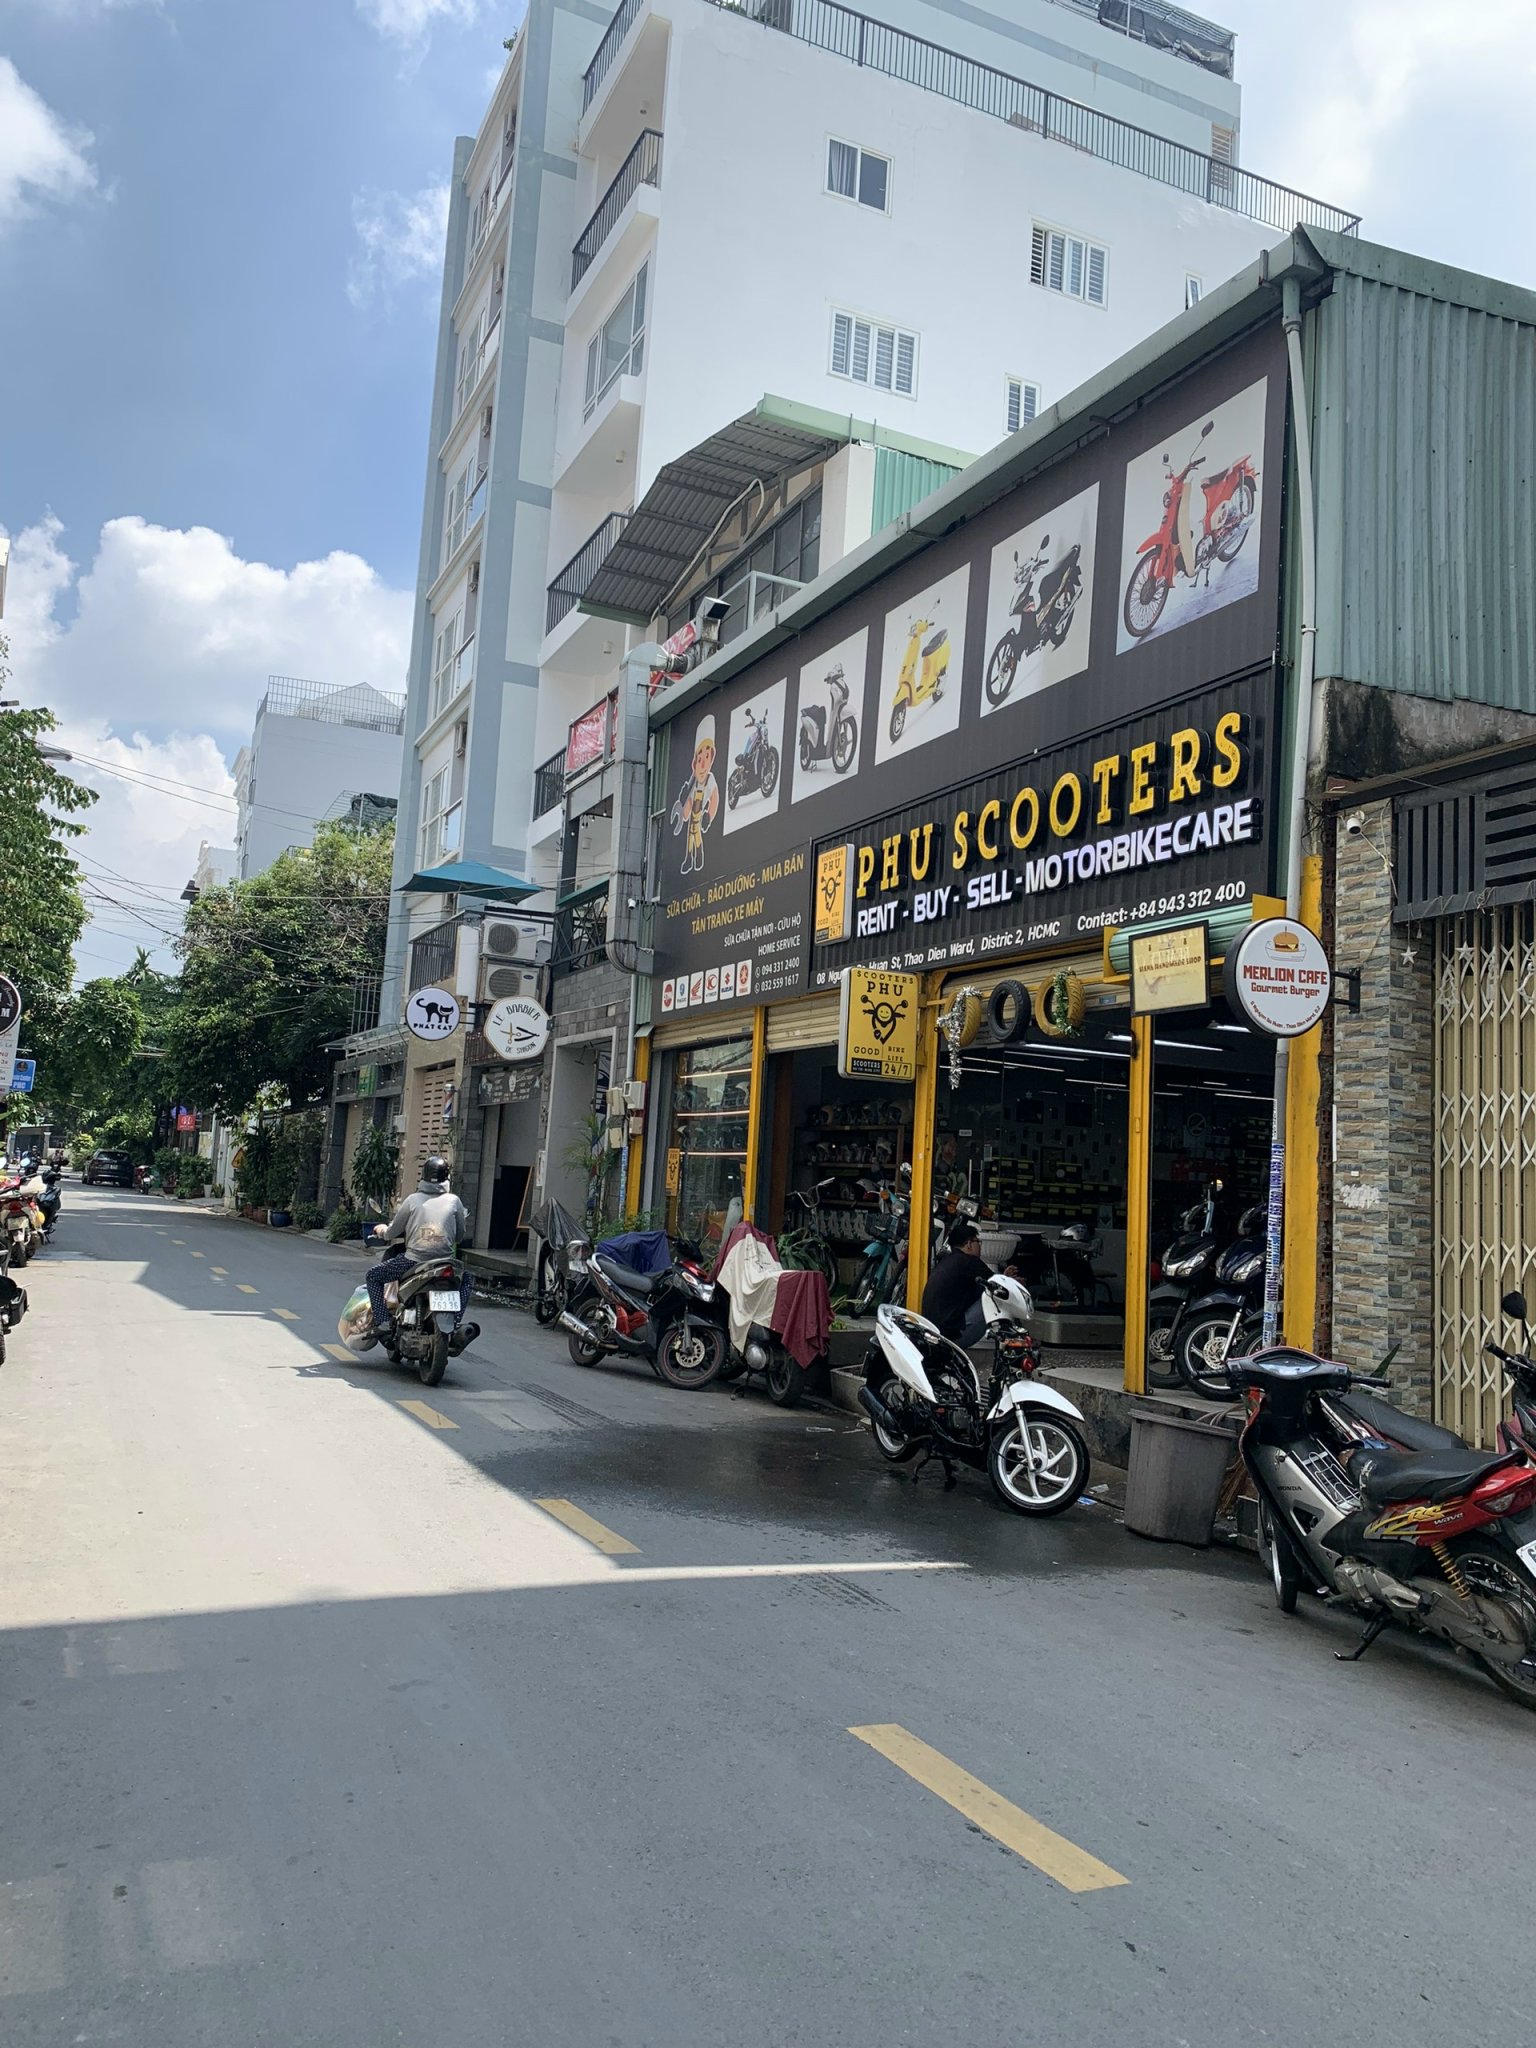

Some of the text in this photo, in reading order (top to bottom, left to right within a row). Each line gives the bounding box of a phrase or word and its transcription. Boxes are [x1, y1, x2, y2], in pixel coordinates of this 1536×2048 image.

[856, 711, 1241, 898] PHU SCOOTERS
[762, 861, 782, 884] MUA
[784, 853, 804, 876] BÁN
[824, 858, 841, 873] PHU
[857, 900, 898, 937] RENT
[914, 886, 952, 924] BUY
[967, 869, 1012, 909] SELL
[1025, 799, 1252, 894] MOTORBIKECARE
[706, 909, 733, 932] TRANG
[734, 904, 744, 920] XE
[746, 896, 764, 918] MÁY
[816, 972, 826, 984] 08
[904, 952, 924, 967] Thao
[928, 947, 946, 962] Dien
[950, 939, 975, 957] Ward,
[980, 932, 1013, 951] Distric
[1028, 921, 1060, 941] HCMC
[1077, 906, 1128, 931] Contact:
[1130, 900, 1156, 920] +84
[1158, 894, 1185, 913] 943
[1188, 888, 1212, 908] 312
[1215, 880, 1246, 902] 400
[758, 944, 776, 956] HOME
[776, 934, 800, 952] SERVICE
[762, 957, 800, 975] 094 331 2400
[1243, 965, 1328, 985] MERLION CAFE
[761, 981, 771, 992] 032
[772, 978, 783, 989] 559
[784, 974, 799, 986] 1617
[856, 970, 914, 984] SCOOTERS
[867, 980, 903, 996] PHU
[1251, 982, 1320, 998] Gourmet Burger
[854, 1046, 880, 1055] GOOD
[853, 1060, 880, 1069] SCOOTERS
[884, 1062, 908, 1076] 24/7
